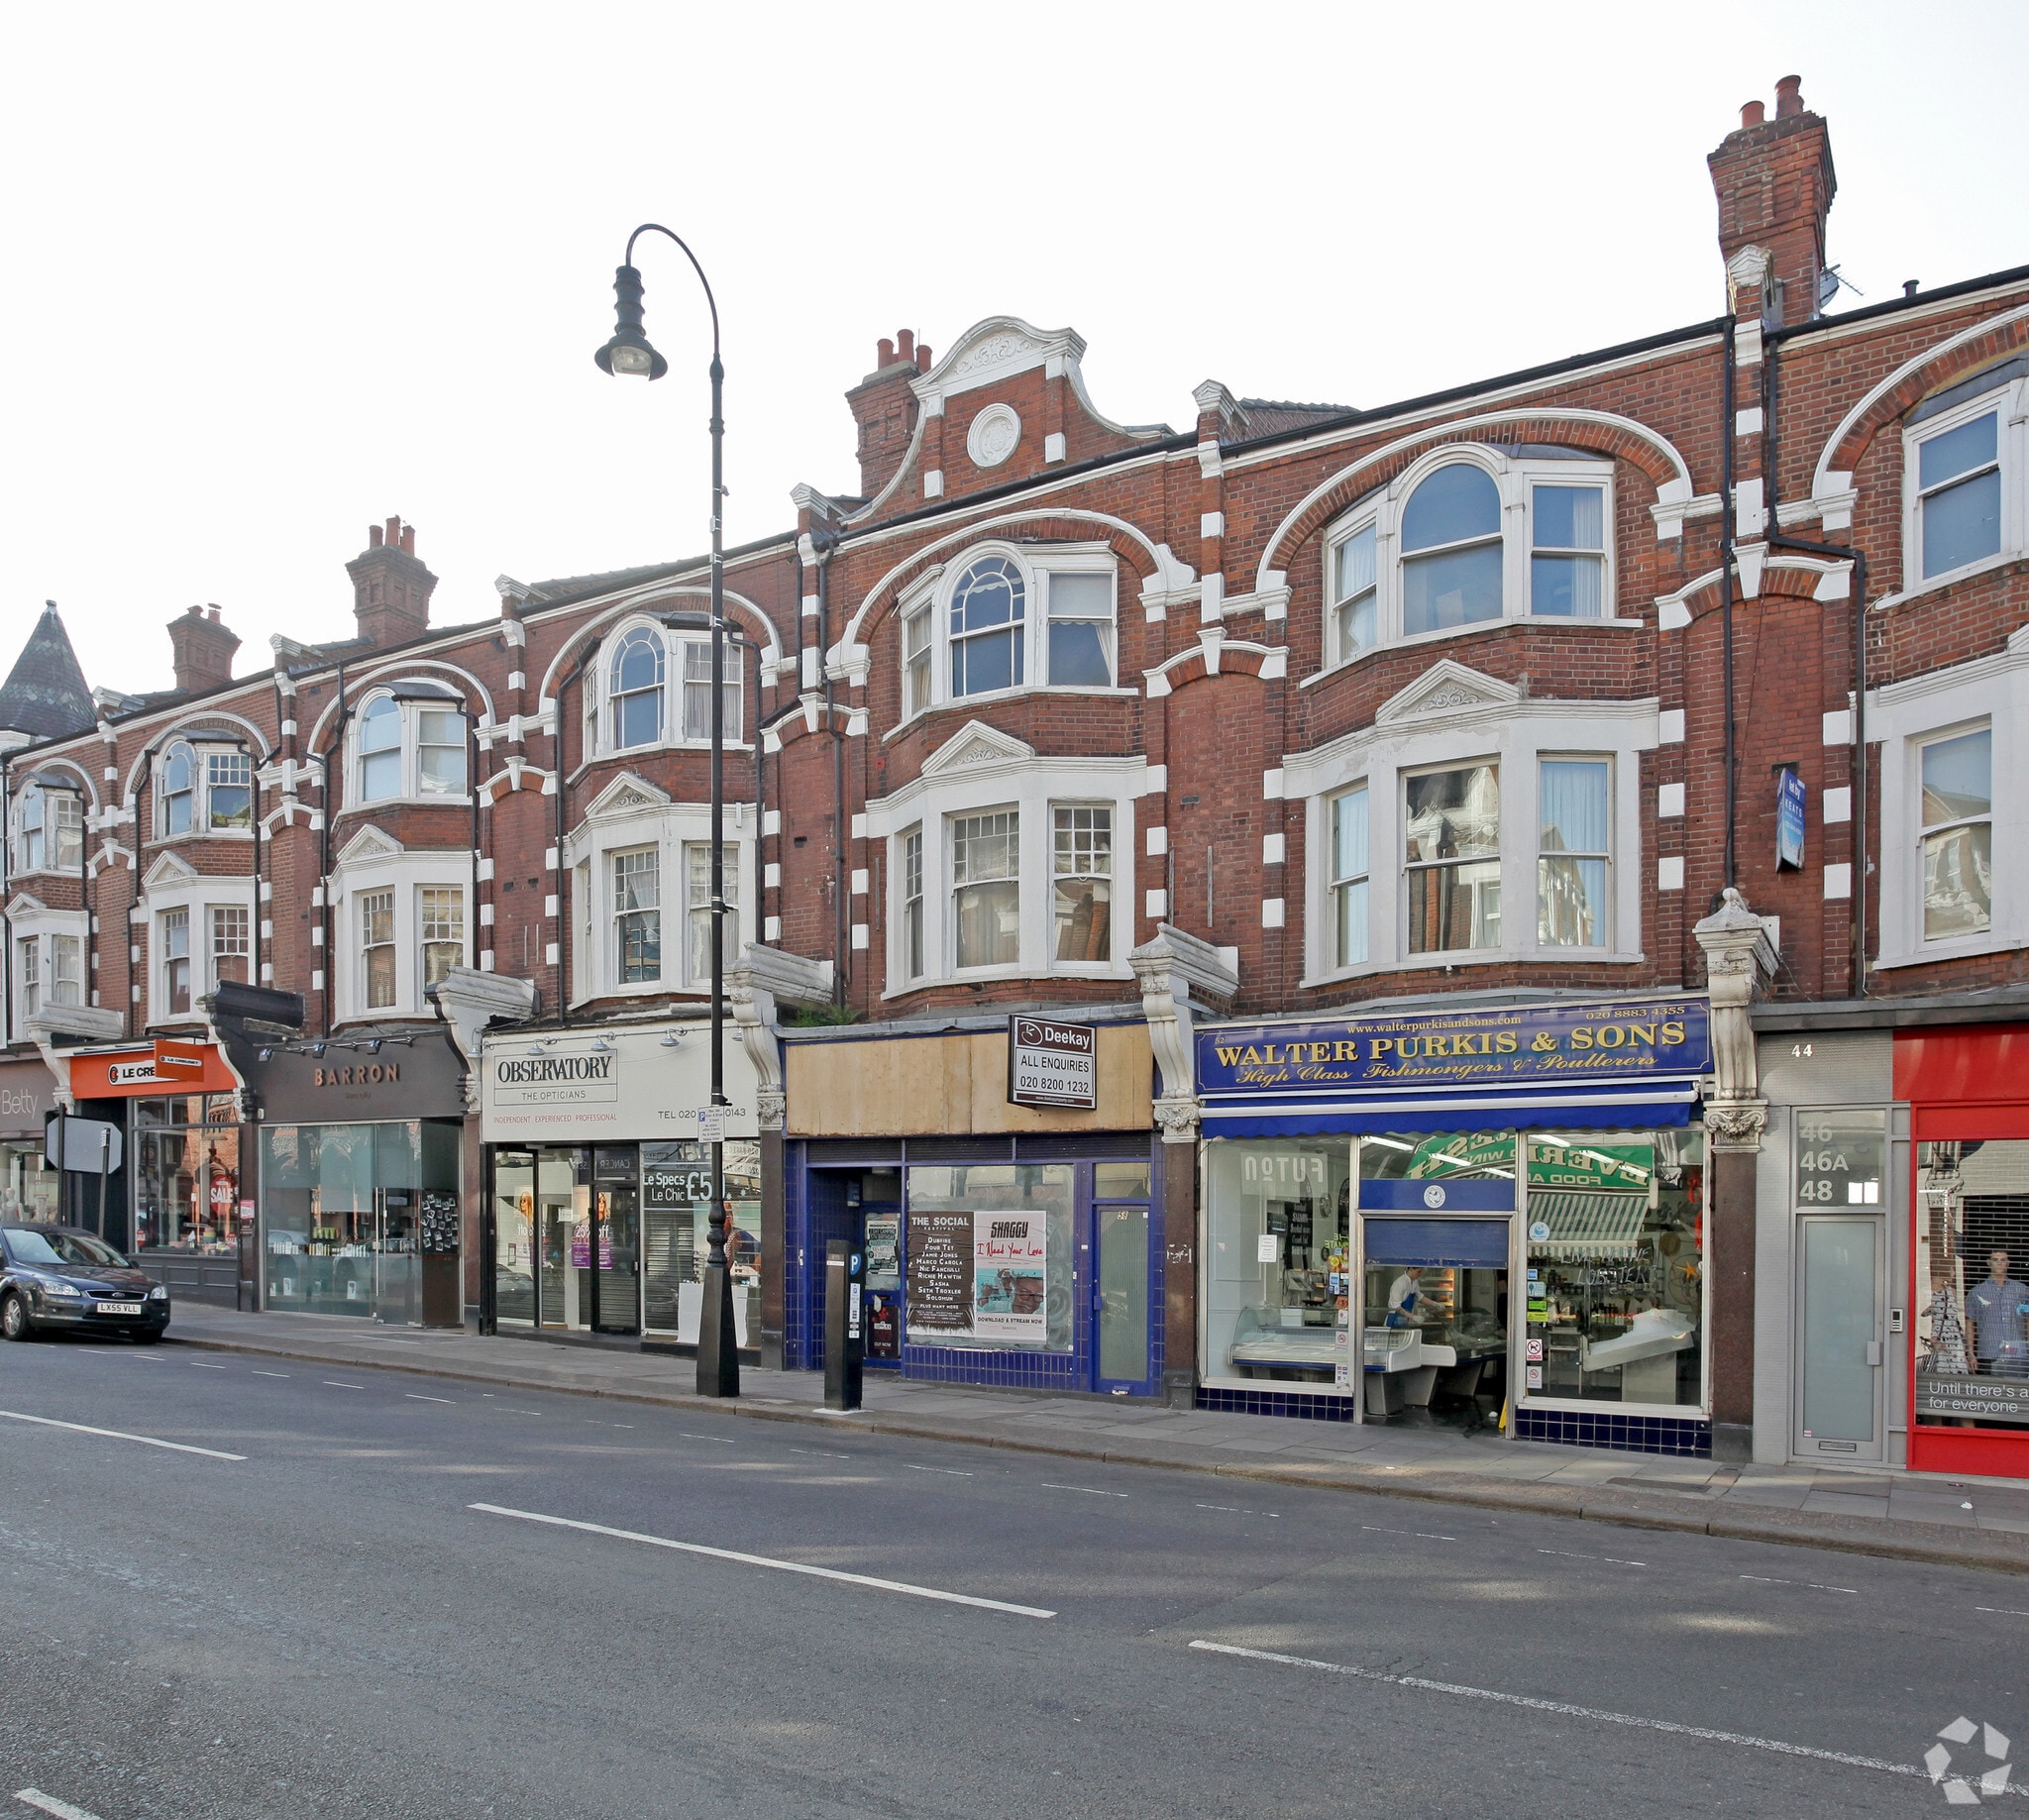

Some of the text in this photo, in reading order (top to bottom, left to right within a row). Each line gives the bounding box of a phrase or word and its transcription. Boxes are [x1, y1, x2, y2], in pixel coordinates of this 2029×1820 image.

[1785, 798, 1802, 817] KEATS
[1586, 1006, 1685, 1020] 020 8883 4355
[1347, 1016, 1521, 1033] www.walterpurkisandsons.com
[1045, 1027, 1090, 1050] Deekay
[1215, 1021, 1686, 1067] WALTER PURKIS & SONS
[1791, 1044, 1813, 1057] 44
[498, 1056, 612, 1082] OBSERVATORY
[1021, 1055, 1089, 1072] ALL ENQUIRIES
[1236, 1068, 1292, 1087] High
[1296, 1066, 1352, 1081] Class
[1362, 1062, 1503, 1079] Fishmongers
[1536, 1052, 1658, 1071] Poulterers
[122, 1067, 156, 1079] LE CRE
[315, 1063, 398, 1086] BARRON
[1020, 1076, 1089, 1093] 020 8200 1232
[540, 1090, 586, 1099] OPTICIANS
[2, 1090, 38, 1119] Betty
[678, 1110, 696, 1118] 020
[725, 1108, 746, 1117] 0143
[535, 1115, 571, 1123] EXPERIENCED
[1799, 1122, 1832, 1142] 46
[1800, 1151, 1849, 1171] 46A
[642, 1173, 654, 1185] Le
[656, 1172, 685, 1188] Specs
[211, 1188, 233, 1203] SALE
[651, 1188, 685, 1201] Le Chic
[1799, 1180, 1832, 1201] 48
[912, 1217, 969, 1226] THE SOCIAL
[991, 1221, 1029, 1238] SHAGGY
[977, 1243, 984, 1255] I
[986, 1240, 1004, 1257] Need
[1008, 1242, 1023, 1259] Your
[851, 1256, 858, 1271] P
[1929, 1382, 1960, 1394] Until
[1965, 1383, 2014, 1397] there's
[1929, 1396, 2018, 1413] for everyone
